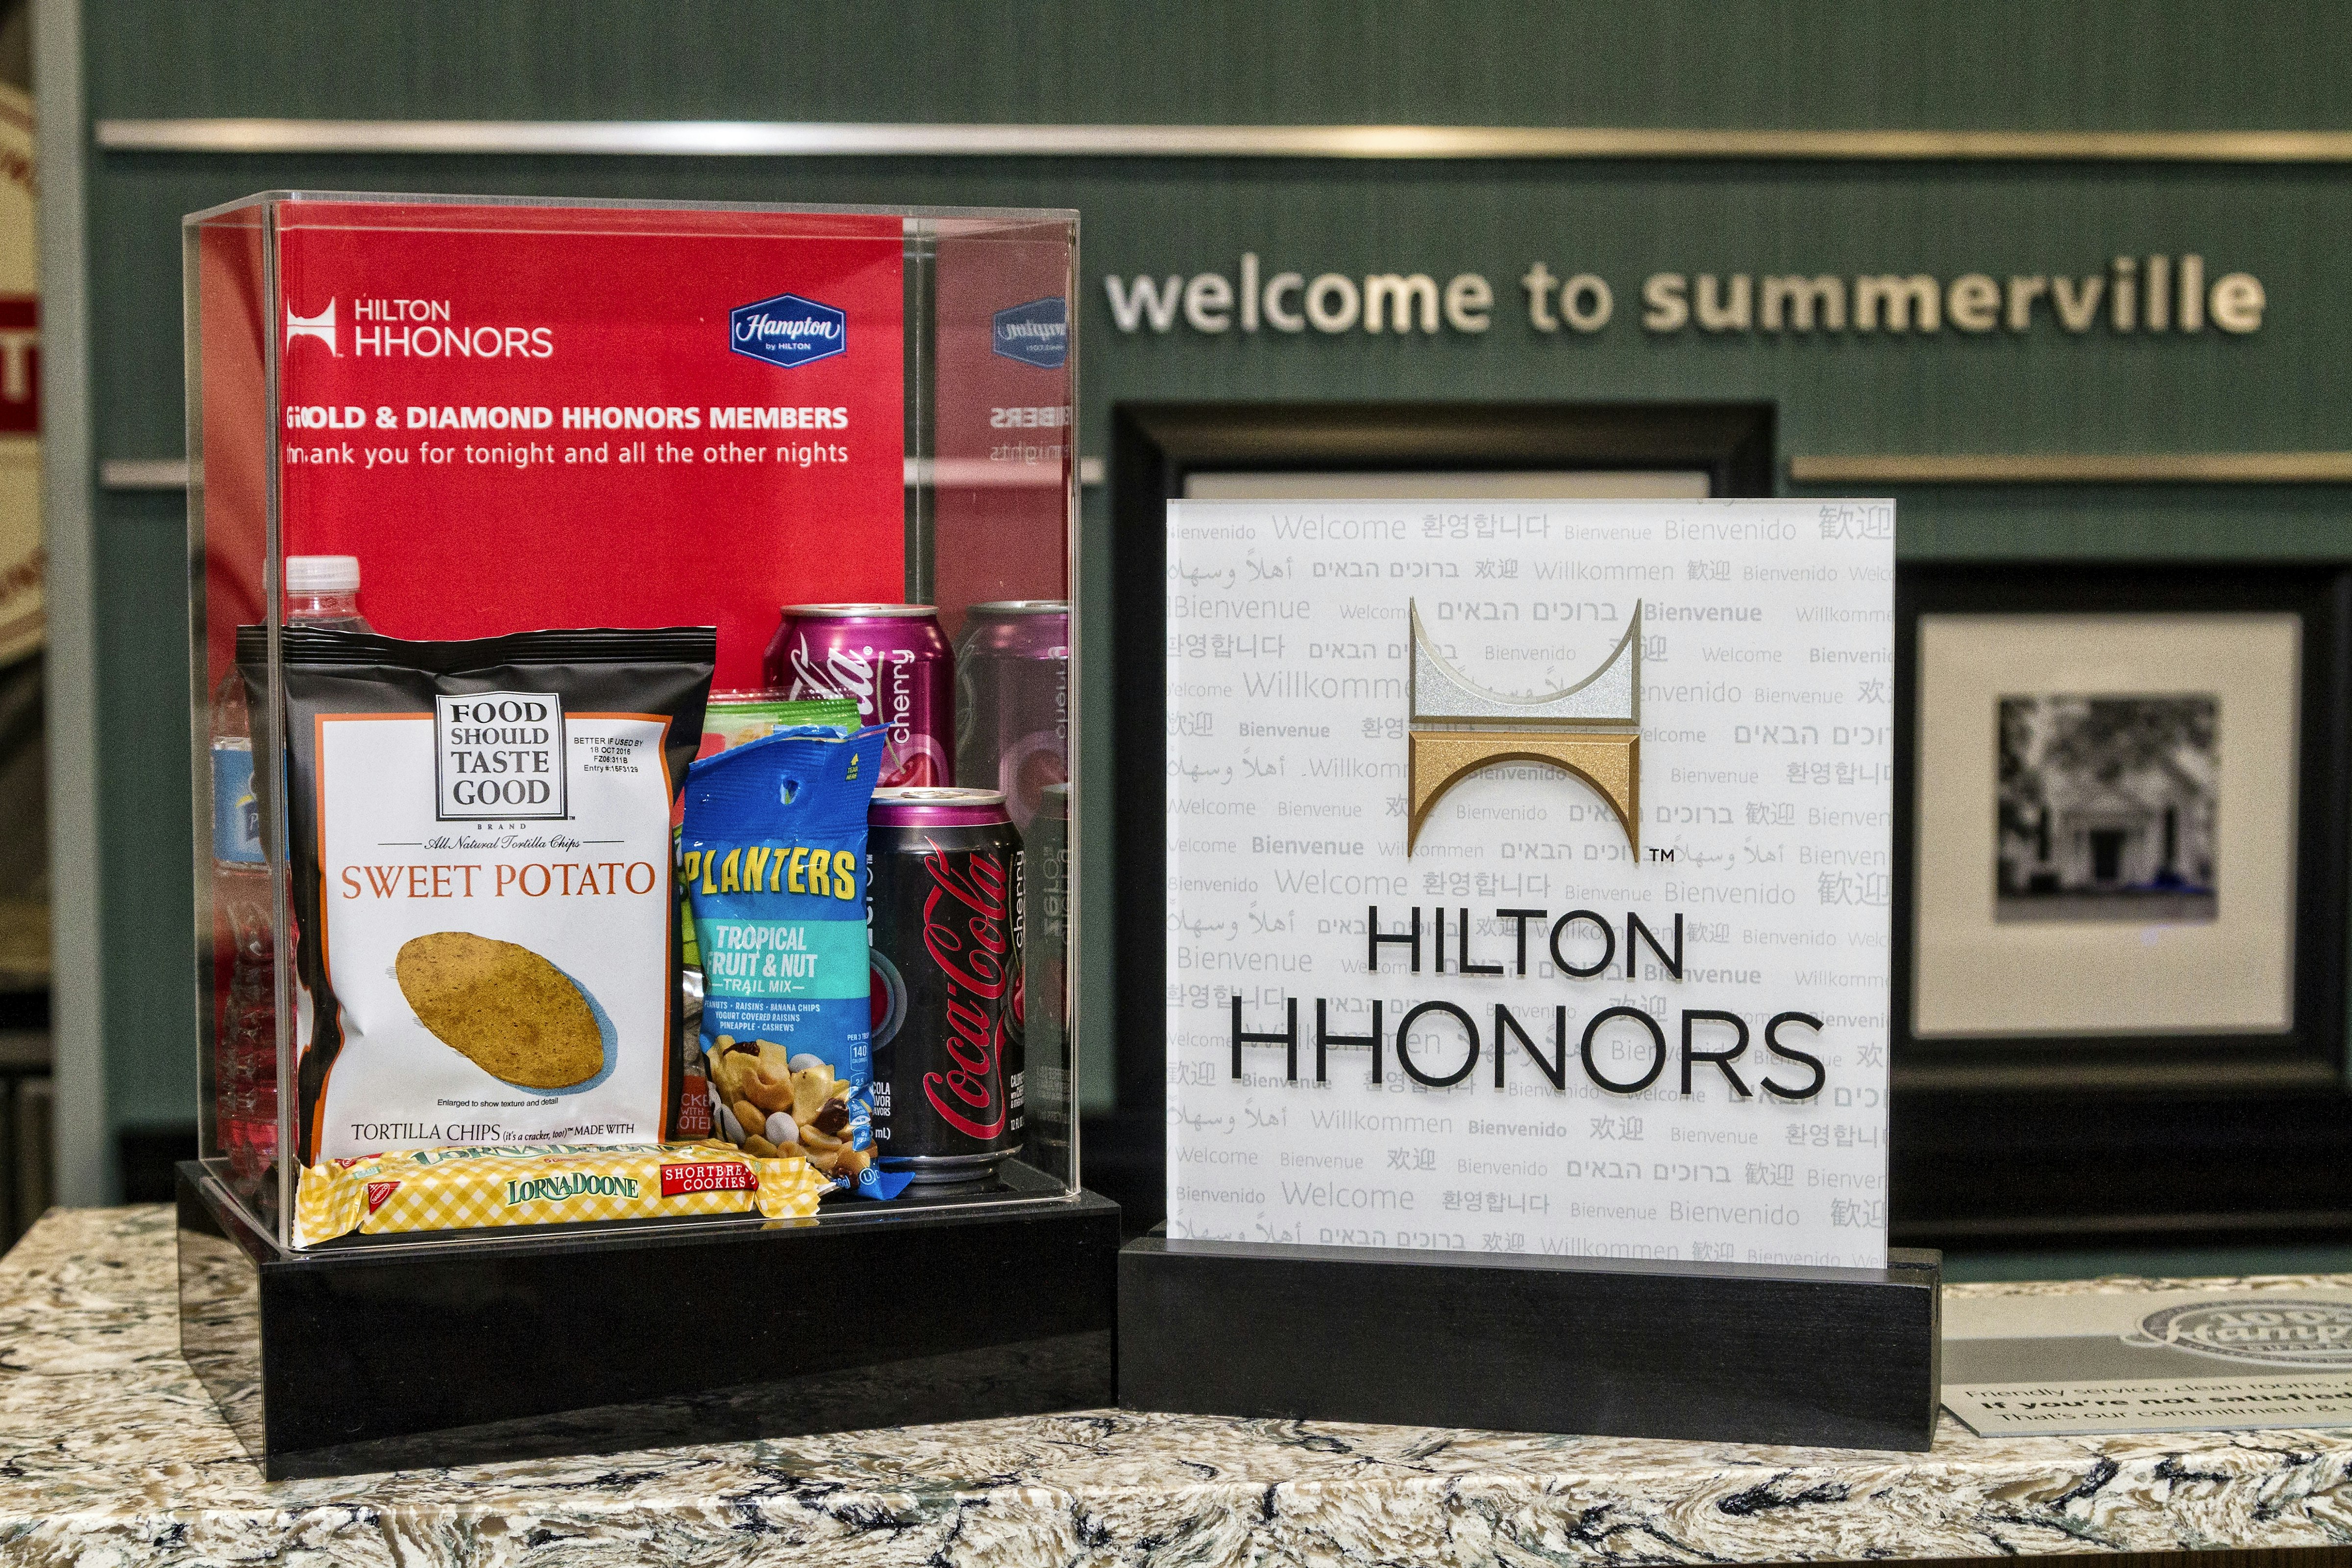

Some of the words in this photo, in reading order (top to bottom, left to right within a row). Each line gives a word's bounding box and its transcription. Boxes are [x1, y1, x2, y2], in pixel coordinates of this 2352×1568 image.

[1105, 251, 1494, 334] welcome
[1522, 261, 1614, 333] to
[1642, 254, 2266, 334] summerville
[355, 299, 450, 320] HILTON
[736, 313, 840, 341] Hampton
[355, 326, 553, 357] HHONORS
[376, 406, 397, 428] &
[407, 406, 552, 429] DIAMOND
[563, 407, 700, 429] HHONORS
[710, 407, 848, 429] MEMBERS
[365, 446, 409, 469] you
[420, 441, 455, 463] for
[466, 441, 555, 469] tonight
[565, 442, 609, 463] and
[618, 442, 645, 463] all
[656, 442, 694, 463] the
[703, 442, 766, 463] other
[777, 442, 848, 467] nights
[1273, 515, 1406, 539] Welcome
[1565, 525, 1651, 540] Bienvenue
[1666, 518, 1796, 540] Bienvenido
[1534, 561, 1674, 581] Willkommen
[1744, 565, 1838, 582] Bienvenido
[1175, 595, 1310, 619] Bienvenue
[1644, 603, 1763, 621] Bienvenue
[1703, 647, 1782, 662] Welcome
[894, 649, 915, 744] cherry
[450, 701, 548, 723] FOOD
[451, 728, 549, 746] SHOULD
[451, 751, 550, 774] TASTE
[453, 780, 551, 805] GOOD
[1456, 805, 1547, 821] Bienvenido
[424, 836, 449, 849] All
[448, 835, 500, 849] Natural
[501, 835, 546, 848] Tortilla
[548, 834, 580, 852] Chips
[1252, 836, 1364, 855] Bienvenue
[1649, 849, 1675, 862] TM
[342, 865, 481, 899] SWEET
[494, 861, 656, 897] POTATO
[684, 846, 856, 901] PLANTERS
[1274, 870, 1407, 895] Welcome
[1013, 850, 1025, 948] cherry
[1666, 882, 1795, 904] Bienvenido
[716, 925, 807, 951] TROPICAL
[1369, 905, 1683, 980] HILTON
[707, 952, 760, 977] FRUIT
[762, 953, 778, 978] &
[781, 953, 818, 978] NUT
[1177, 947, 1312, 972] Bienvenue
[723, 978, 765, 994] TRAIL
[769, 979, 792, 993] MIX
[923, 835, 1007, 1141] Coca-Cola
[705, 1000, 728, 1009] PEANUTS
[735, 1002, 764, 1011] RAISINS
[770, 1003, 796, 1012] BANANA
[798, 1004, 821, 1012] CHIPS
[715, 1011, 739, 1020] YOGURT
[741, 1012, 771, 1021] COVERED
[772, 1013, 800, 1022] RAISINS
[720, 1021, 756, 1030] PINEAPPLE
[762, 1023, 794, 1032] CASHEWS
[853, 1045, 867, 1058] 140
[1232, 995, 1825, 1100] HHONORS
[438, 1099, 469, 1107] Enlarged
[541, 1097, 559, 1106] detail
[351, 1122, 441, 1141] TORTILLA
[447, 1124, 500, 1141] CHIPS
[503, 1130, 516, 1142] (it's
[525, 1129, 551, 1141] cracker,
[574, 1125, 604, 1136] MADE
[606, 1124, 635, 1134] WITH
[1311, 1110, 1451, 1132] Willkommen
[1469, 1121, 1568, 1138] Bienvenido
[1177, 1147, 1258, 1165] Welcome
[1458, 1158, 1547, 1176] Bienvenido
[371, 1183, 389, 1203] NABISCO
[683, 1176, 746, 1191] COOKIES
[1176, 1186, 1265, 1204] Bienvenido
[1281, 1180, 1414, 1210] Welcome
[1670, 1200, 1800, 1226] Bienvenido
[1965, 1388, 2064, 1396] Friendly
[2019, 1399, 2130, 1410] you're
[1995, 1412, 2077, 1421] That's
